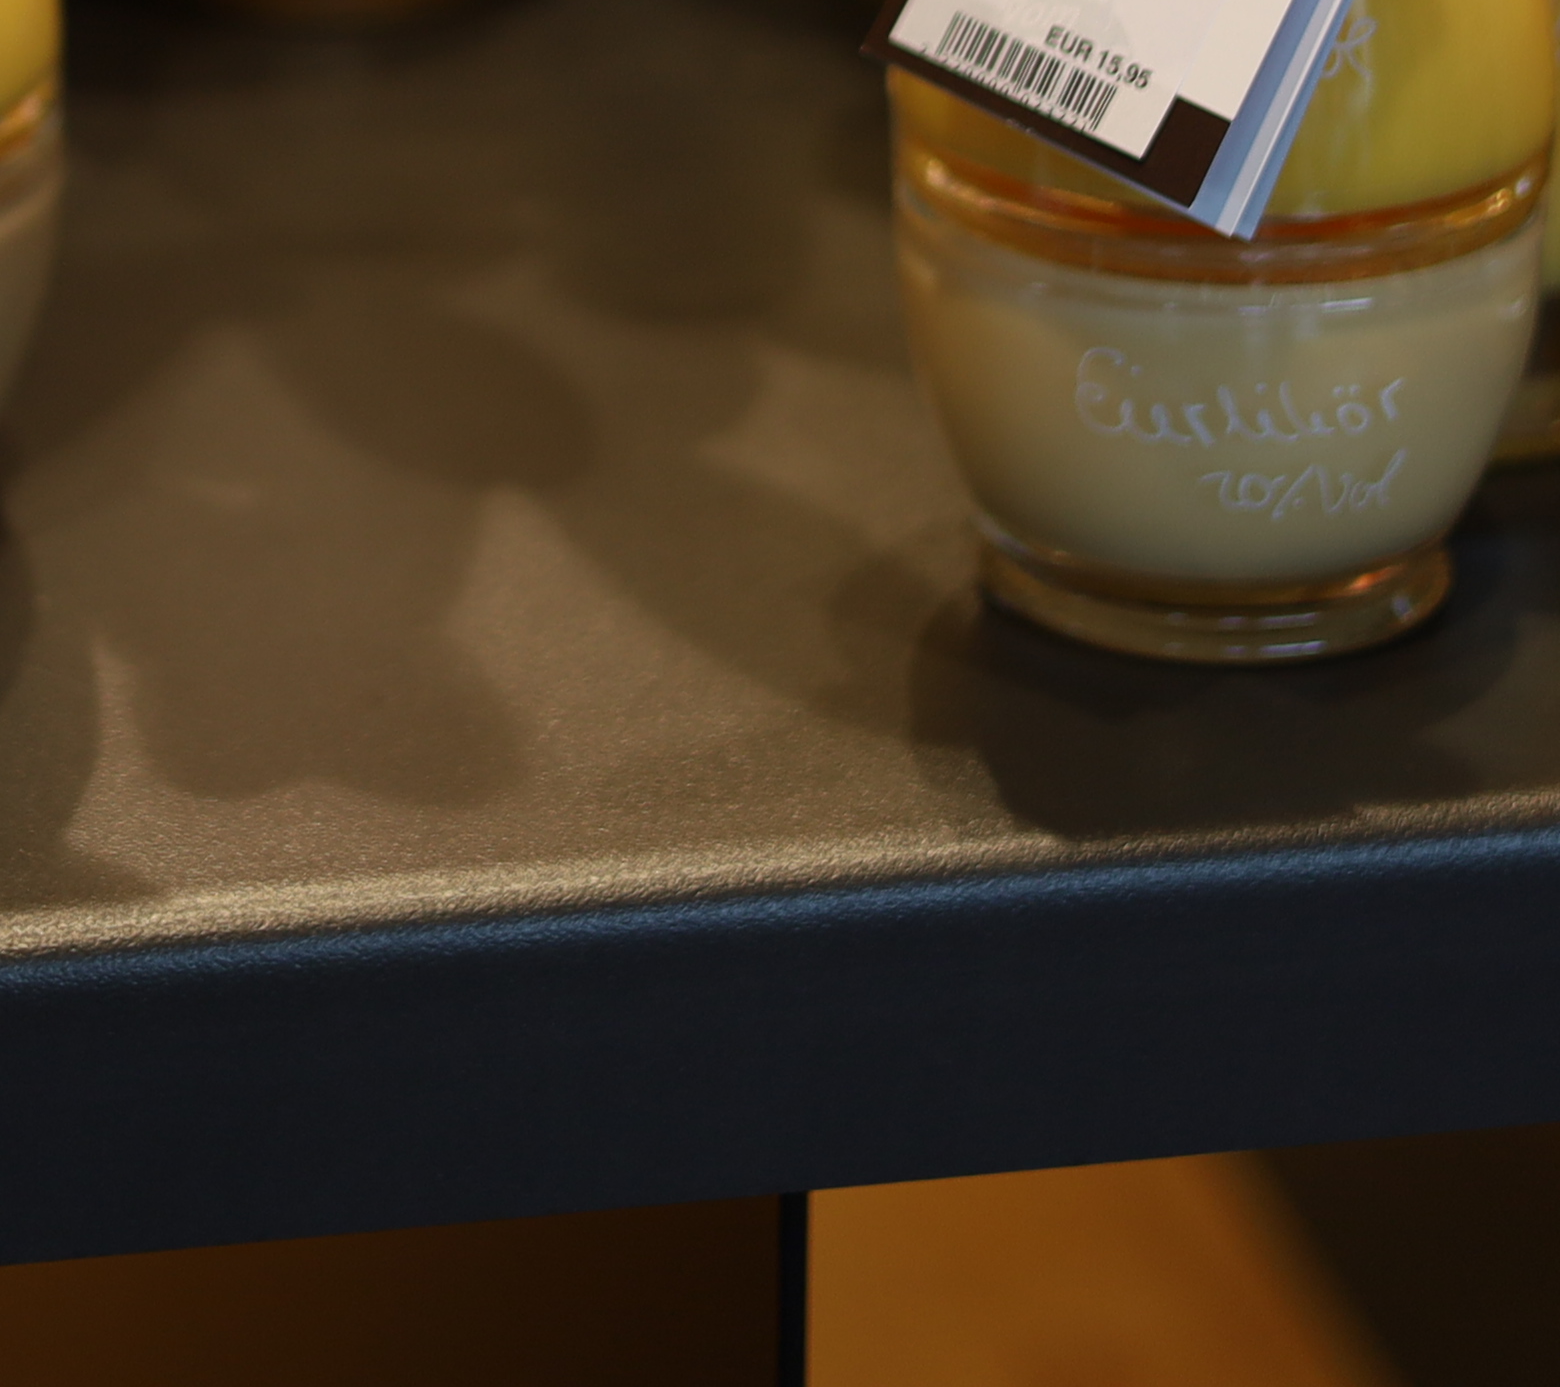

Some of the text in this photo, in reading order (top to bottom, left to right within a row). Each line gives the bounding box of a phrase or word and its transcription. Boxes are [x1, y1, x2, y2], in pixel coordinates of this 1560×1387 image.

[1044, 23, 1155, 90] EUR 15,95
[1074, 345, 1405, 449] Eierlikör
